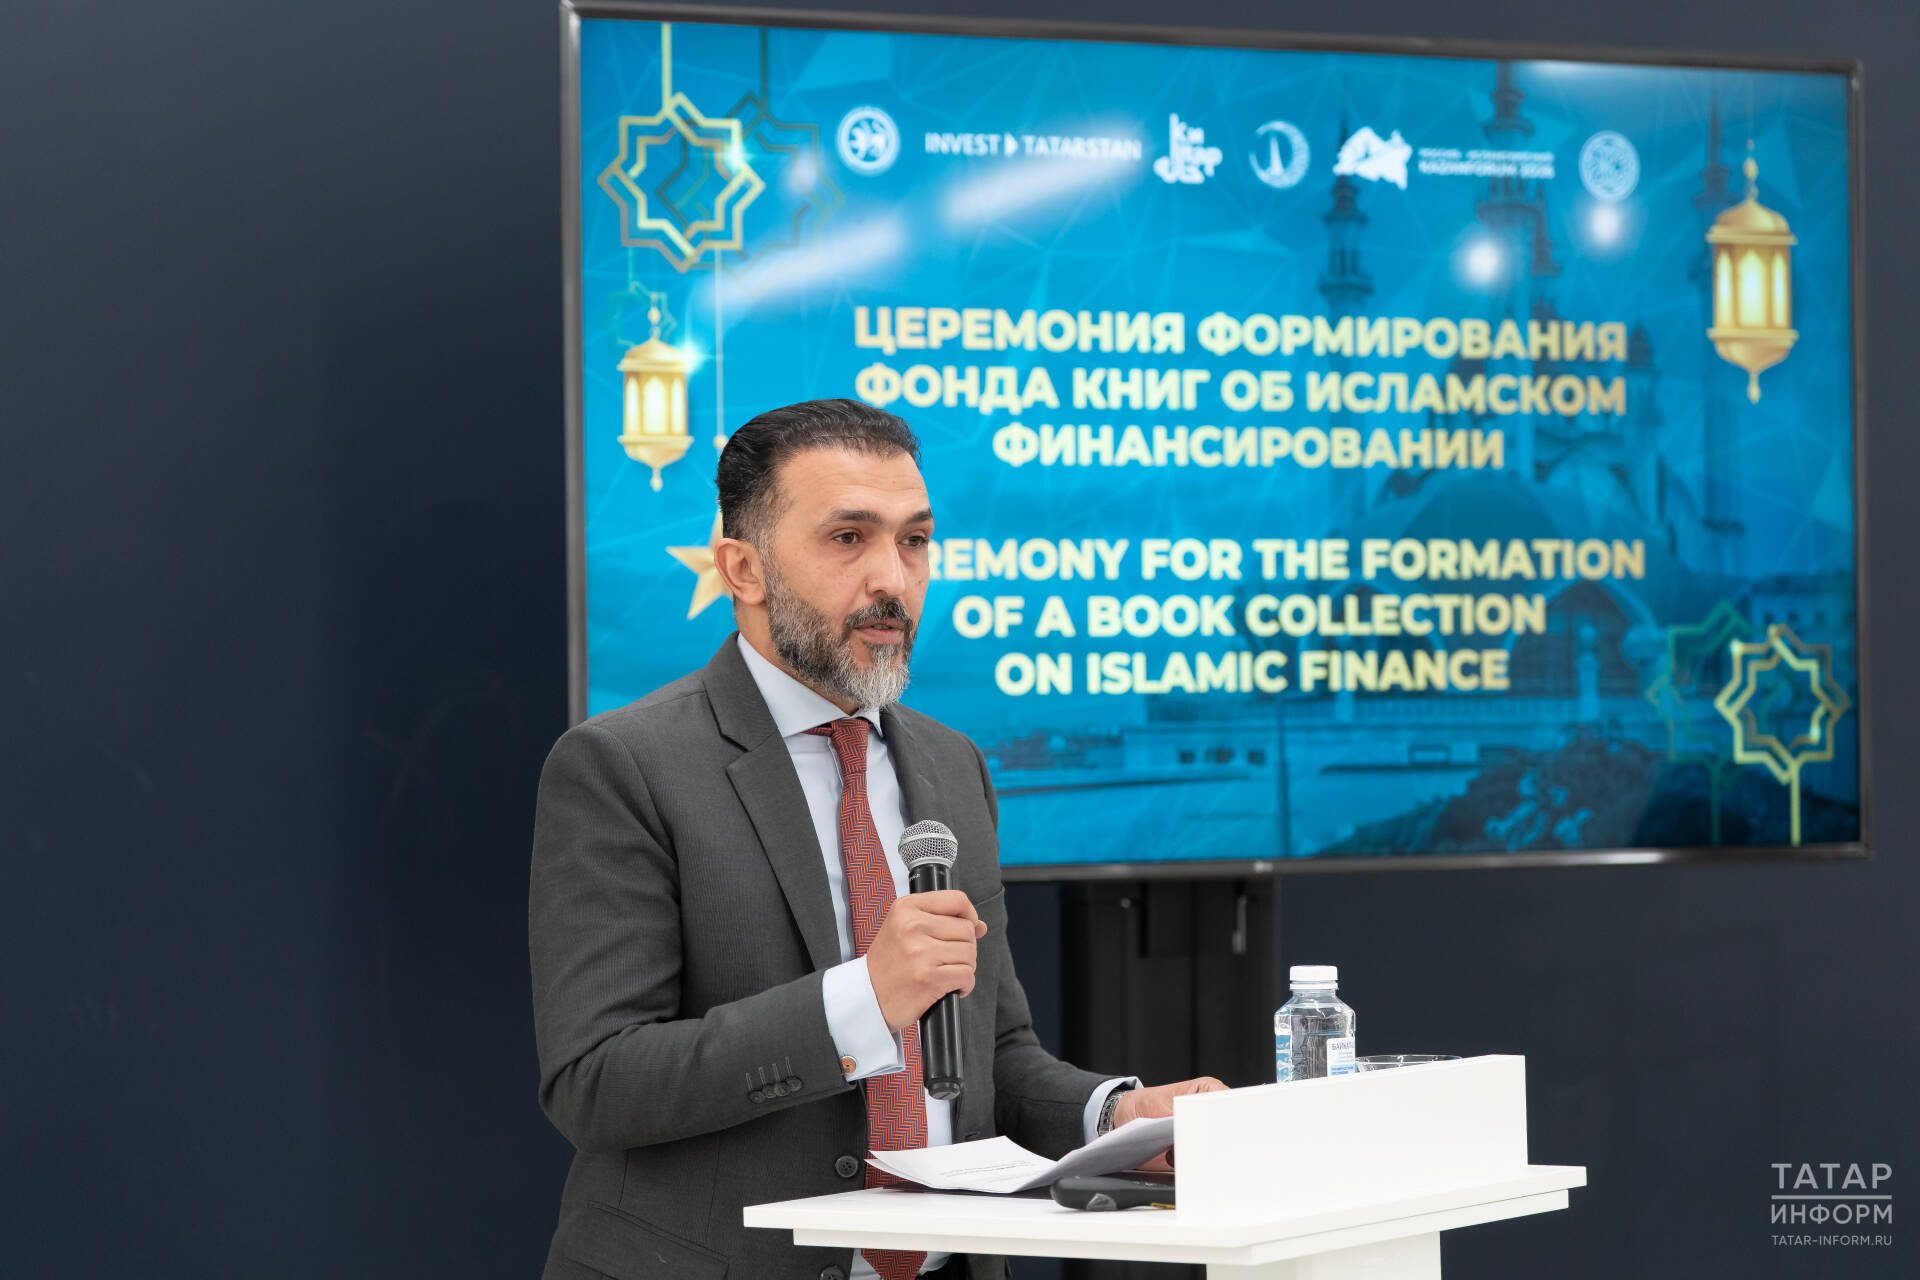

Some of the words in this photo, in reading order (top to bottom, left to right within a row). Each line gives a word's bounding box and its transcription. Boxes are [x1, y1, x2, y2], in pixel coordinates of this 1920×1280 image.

[925, 133, 1000, 156] INVEST
[1024, 136, 1142, 160] TATARSTAN
[854, 306, 1185, 353] ЦЕРЕМОНИЯ
[1197, 311, 1627, 361] ФОРМИРОВАНИЯ
[855, 363, 1059, 414] ФОНДА
[1073, 368, 1210, 410] КНИГ
[1220, 370, 1294, 412] ОБ
[1307, 372, 1627, 416] ИСЛАМСКОМ
[992, 422, 1504, 469] ФИНАНСИРОВАНИИ
[1142, 539, 1243, 581] FOR
[1253, 539, 1350, 580] THE
[1363, 538, 1645, 581] FORMATION
[952, 595, 1024, 639] OF
[1035, 596, 1076, 638] A
[1087, 595, 1235, 638] BOOK
[1245, 594, 1546, 637] COLLECTION
[995, 652, 1073, 696] ON
[1086, 651, 1288, 695] ISLAMIC
[1300, 649, 1510, 692] FINANCE
